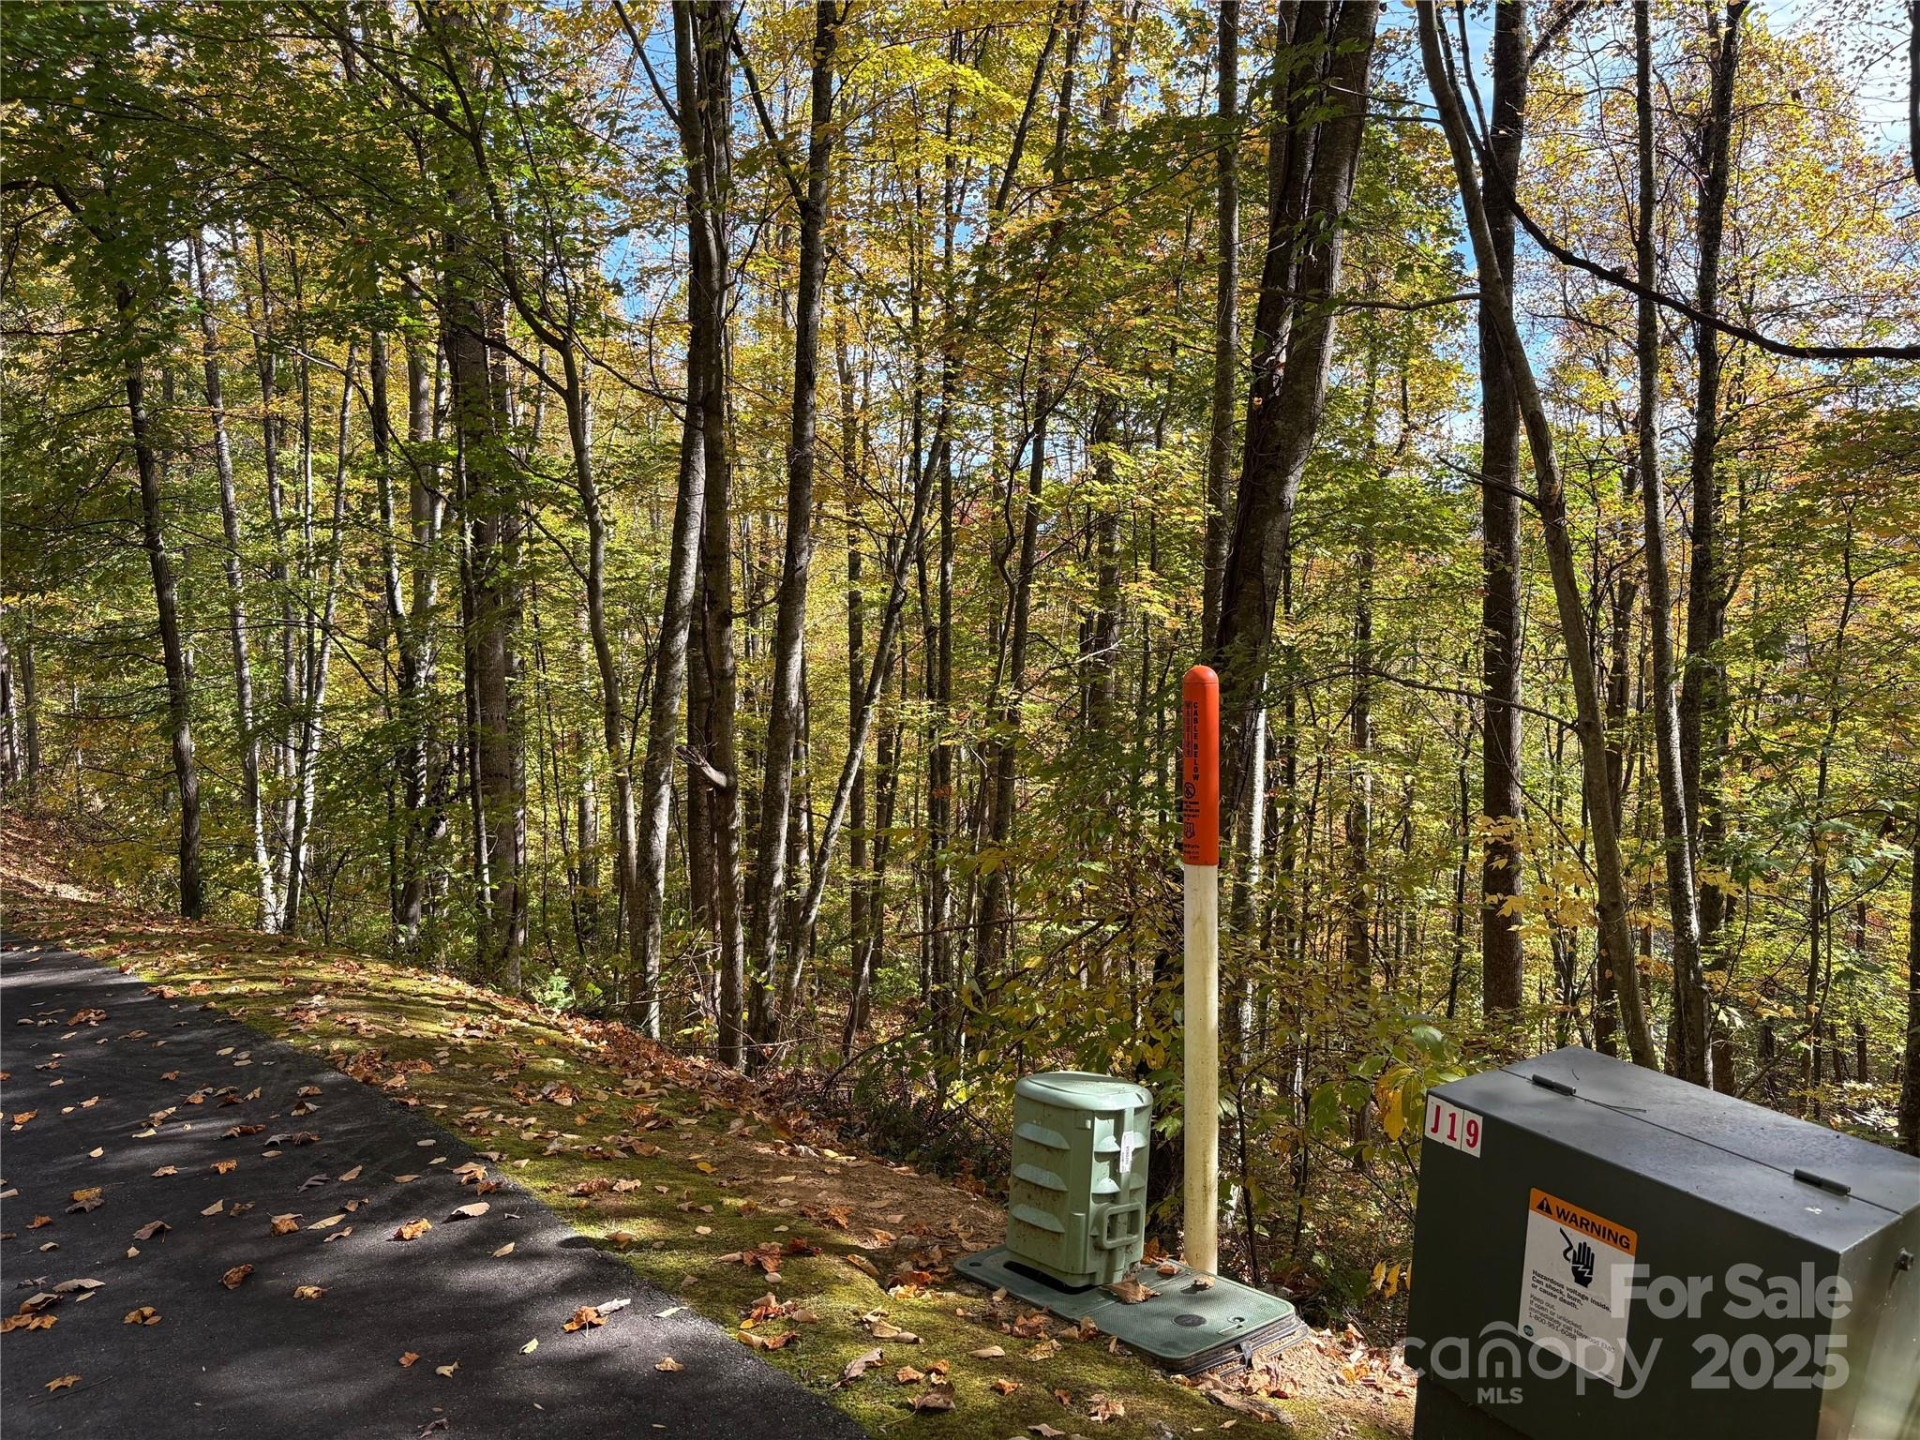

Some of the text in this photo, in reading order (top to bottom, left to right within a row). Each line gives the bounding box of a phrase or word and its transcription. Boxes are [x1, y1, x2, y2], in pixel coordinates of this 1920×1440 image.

[1431, 1105, 1479, 1149] J19
[1556, 1205, 1631, 1250] WARNING
[1530, 1293, 1556, 1311] Keep out.
[1531, 1275, 1583, 1306] Can shock, burn,
[1532, 1269, 1612, 1313] Hazardous voltage inside.
[1539, 1287, 1558, 1300] cause
[1558, 1296, 1579, 1310] death.
[1529, 1305, 1562, 1328] immediately
[1562, 1323, 1573, 1332] call
[1534, 1303, 1549, 1313] open
